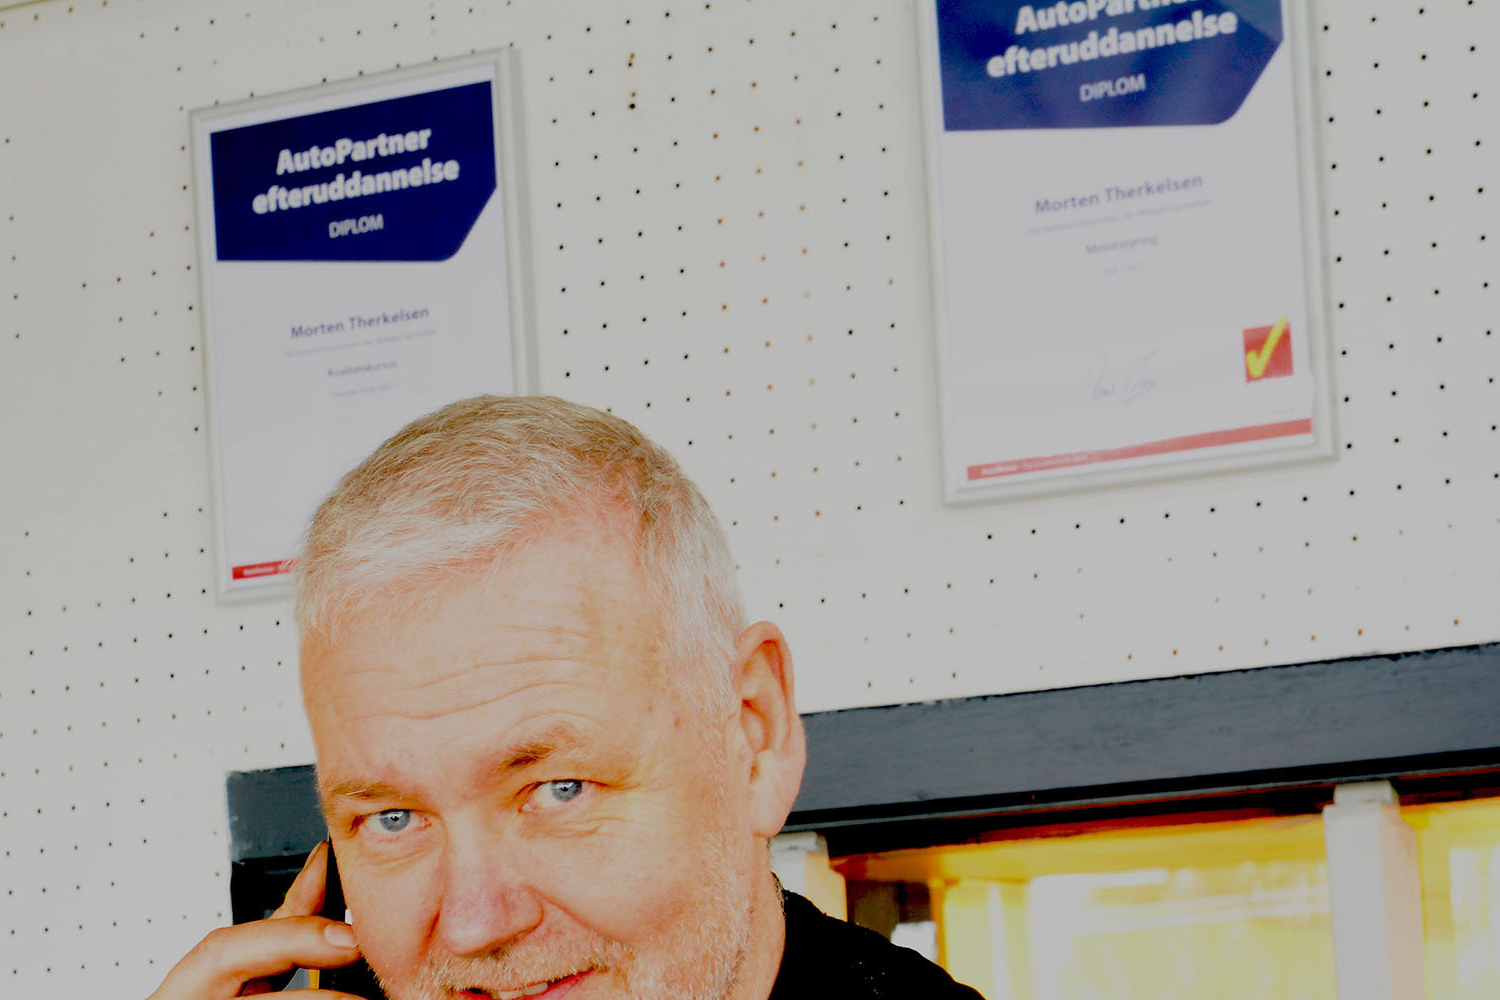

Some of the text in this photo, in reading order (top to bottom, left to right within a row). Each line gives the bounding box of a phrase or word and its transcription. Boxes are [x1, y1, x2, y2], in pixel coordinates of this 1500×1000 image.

[1015, 0, 1197, 34] AutoPar
[986, 10, 1238, 77] efteruddannelse
[1079, 73, 1146, 101] DIPLOM
[276, 128, 431, 174] AutoPartner
[252, 158, 460, 214] efteruddannelse
[1035, 175, 1203, 213] Morten Therkelsen
[328, 214, 384, 238] DIPLOM
[291, 308, 430, 338] Morten Therkelsen
